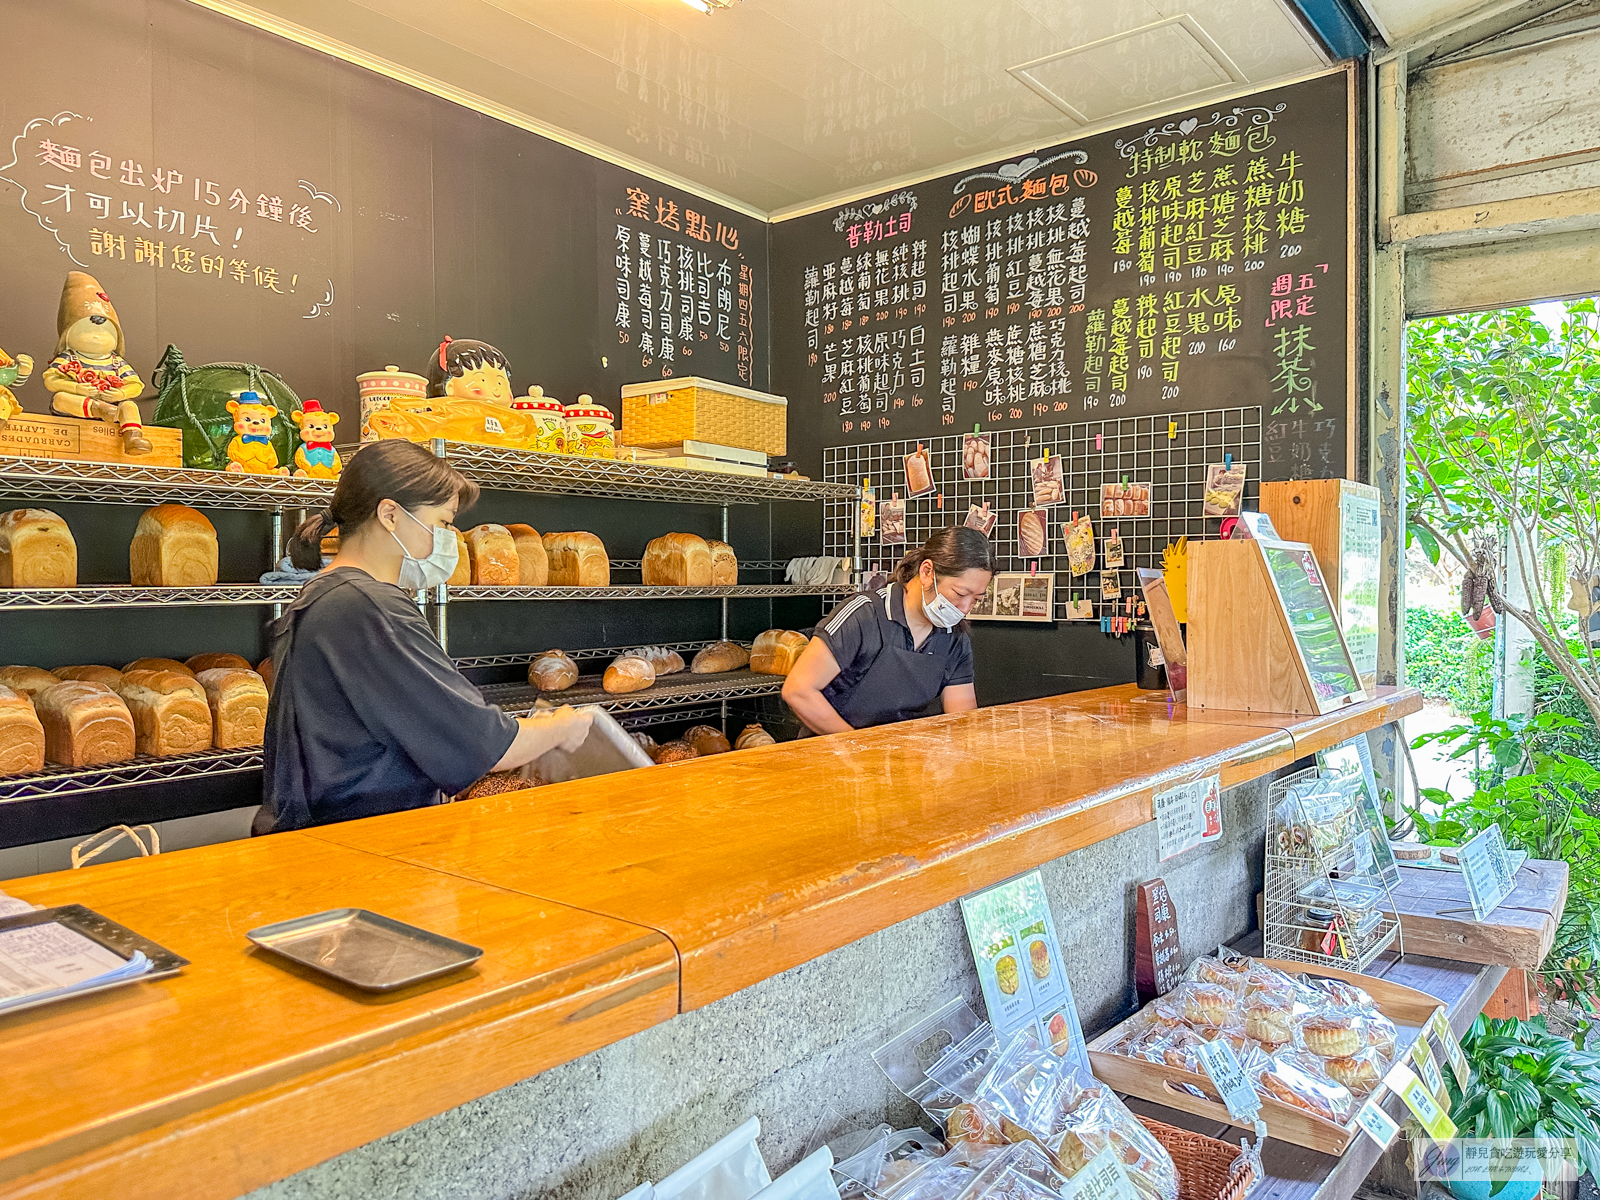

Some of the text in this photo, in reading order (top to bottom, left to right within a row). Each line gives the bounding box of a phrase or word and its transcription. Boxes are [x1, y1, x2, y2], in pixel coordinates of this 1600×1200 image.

[626, 187, 740, 252] 窯烤點心
[974, 173, 1070, 213] 歐式麵包
[1111, 185, 1135, 274] 蔓越莓 180
[1136, 180, 1160, 287] 核桃葡萄 190
[1160, 175, 1186, 283] 原味起司 190
[1183, 169, 1211, 279] 芝麻紅豆 180
[1207, 164, 1240, 276] 蔗糖芝麻 190
[1241, 156, 1274, 273] 蔗糖核桃 200
[1274, 150, 1310, 259] 牛奶糖 200
[615, 224, 633, 344] 原味司康 50
[638, 231, 655, 369] 蔓越莓司康 60
[676, 243, 695, 357] 核桃司康 60
[697, 251, 715, 342] 比司吉 50
[839, 256, 856, 317] 蔓越莓
[874, 249, 890, 308] 無花果
[890, 242, 910, 320] 純核桃 190
[911, 239, 927, 317] 辣起司 190
[941, 230, 960, 329] 核桃起司 190
[959, 225, 982, 323] 蝴蝶水果 200
[984, 219, 1003, 319] 核桃葡萄 190
[1005, 212, 1024, 315] 核桃紅豆 190
[1025, 207, 1048, 320] 核桃蔓越莓 190
[1044, 203, 1068, 317] 核桃無花果 200
[1066, 196, 1091, 314] 蔓越莓起司 200
[657, 239, 675, 378] 巧克力司康 60
[715, 258, 732, 353] 布朗尼 50
[737, 264, 750, 382] 星期四五六限定
[1107, 297, 1133, 408] 蔓越莓起司 200
[1135, 292, 1159, 380] 辣起司 190
[1159, 290, 1185, 400] 紅豆起司 200
[1183, 286, 1214, 355] 水果 200
[1212, 284, 1241, 352] 原味 160
[808, 354, 818, 368] 190
[822, 342, 838, 404] 芒果 200
[838, 338, 856, 434] 芝麻紅豆 180
[856, 334, 875, 433] 核桃葡萄 190
[873, 331, 890, 429] 原味起司 190
[889, 328, 907, 410] 巧克力 190
[912, 393, 924, 407] 160
[960, 333, 984, 391] 雜糧 190
[980, 328, 1006, 423] 燕麥原味 160
[1004, 323, 1028, 419] 蔗糖核桃 200
[1024, 320, 1050, 417] 蔗糖芝麻 190
[1048, 317, 1072, 412] 巧克力核桃 200
[1083, 395, 1099, 411] 190
[1269, 324, 1317, 395] 抹茶
[1, 435, 71, 447] CARRUADES
[53, 428, 68, 436] DE
[942, 414, 955, 426] 190
